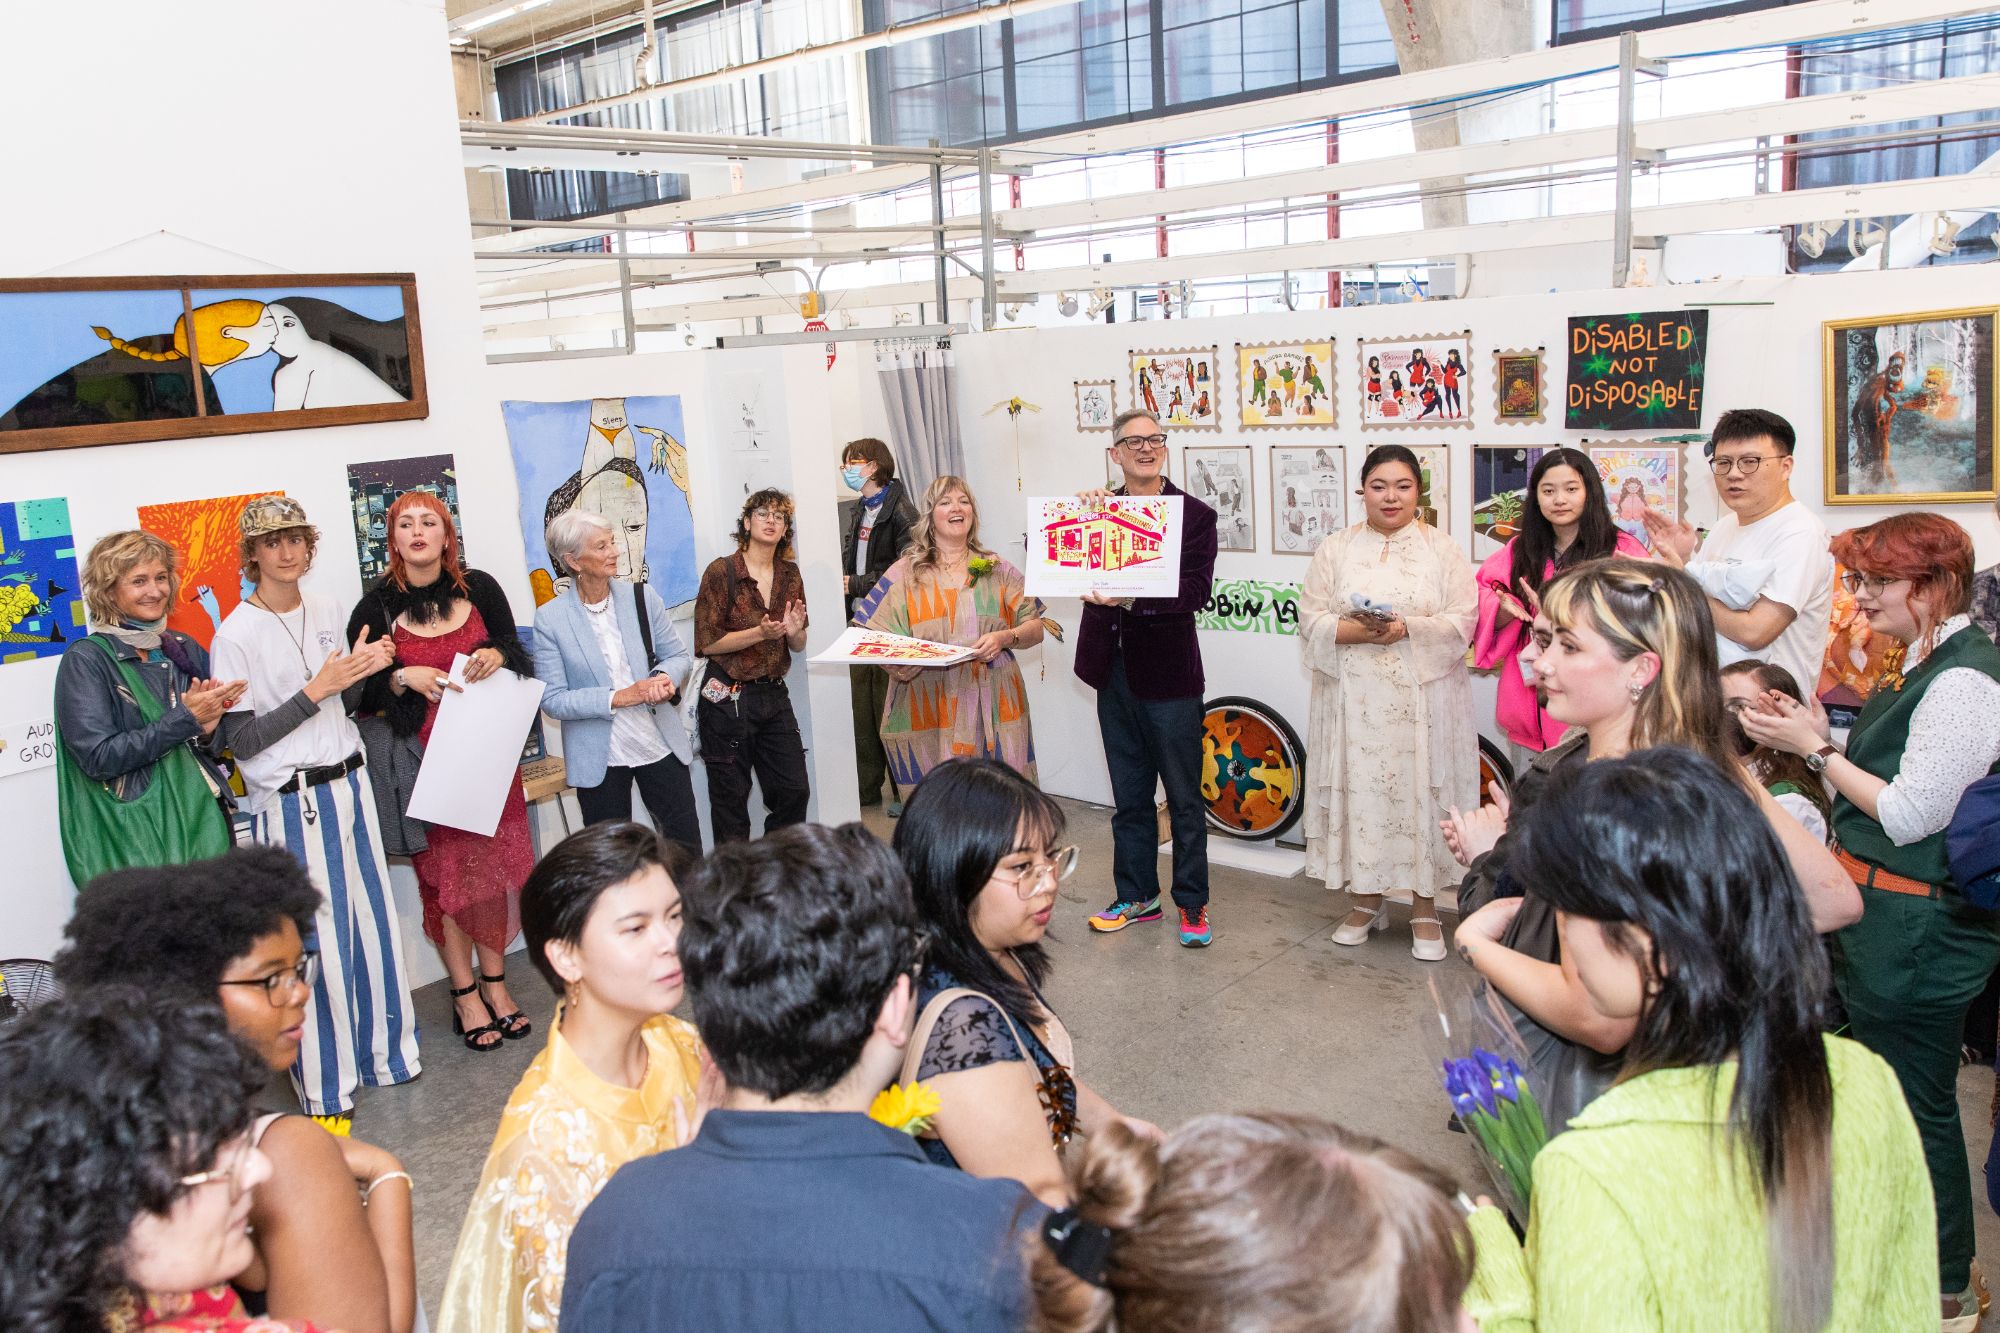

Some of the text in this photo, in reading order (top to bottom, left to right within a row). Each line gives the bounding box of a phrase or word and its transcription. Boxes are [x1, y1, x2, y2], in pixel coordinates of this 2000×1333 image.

[1573, 321, 1693, 355] DiSABLED
[1608, 356, 1658, 374] NOT
[1569, 379, 1700, 411] DiSPOSABLE
[602, 416, 624, 427] Sleep
[1199, 593, 1263, 617] OBiN
[27, 721, 55, 740] AUD
